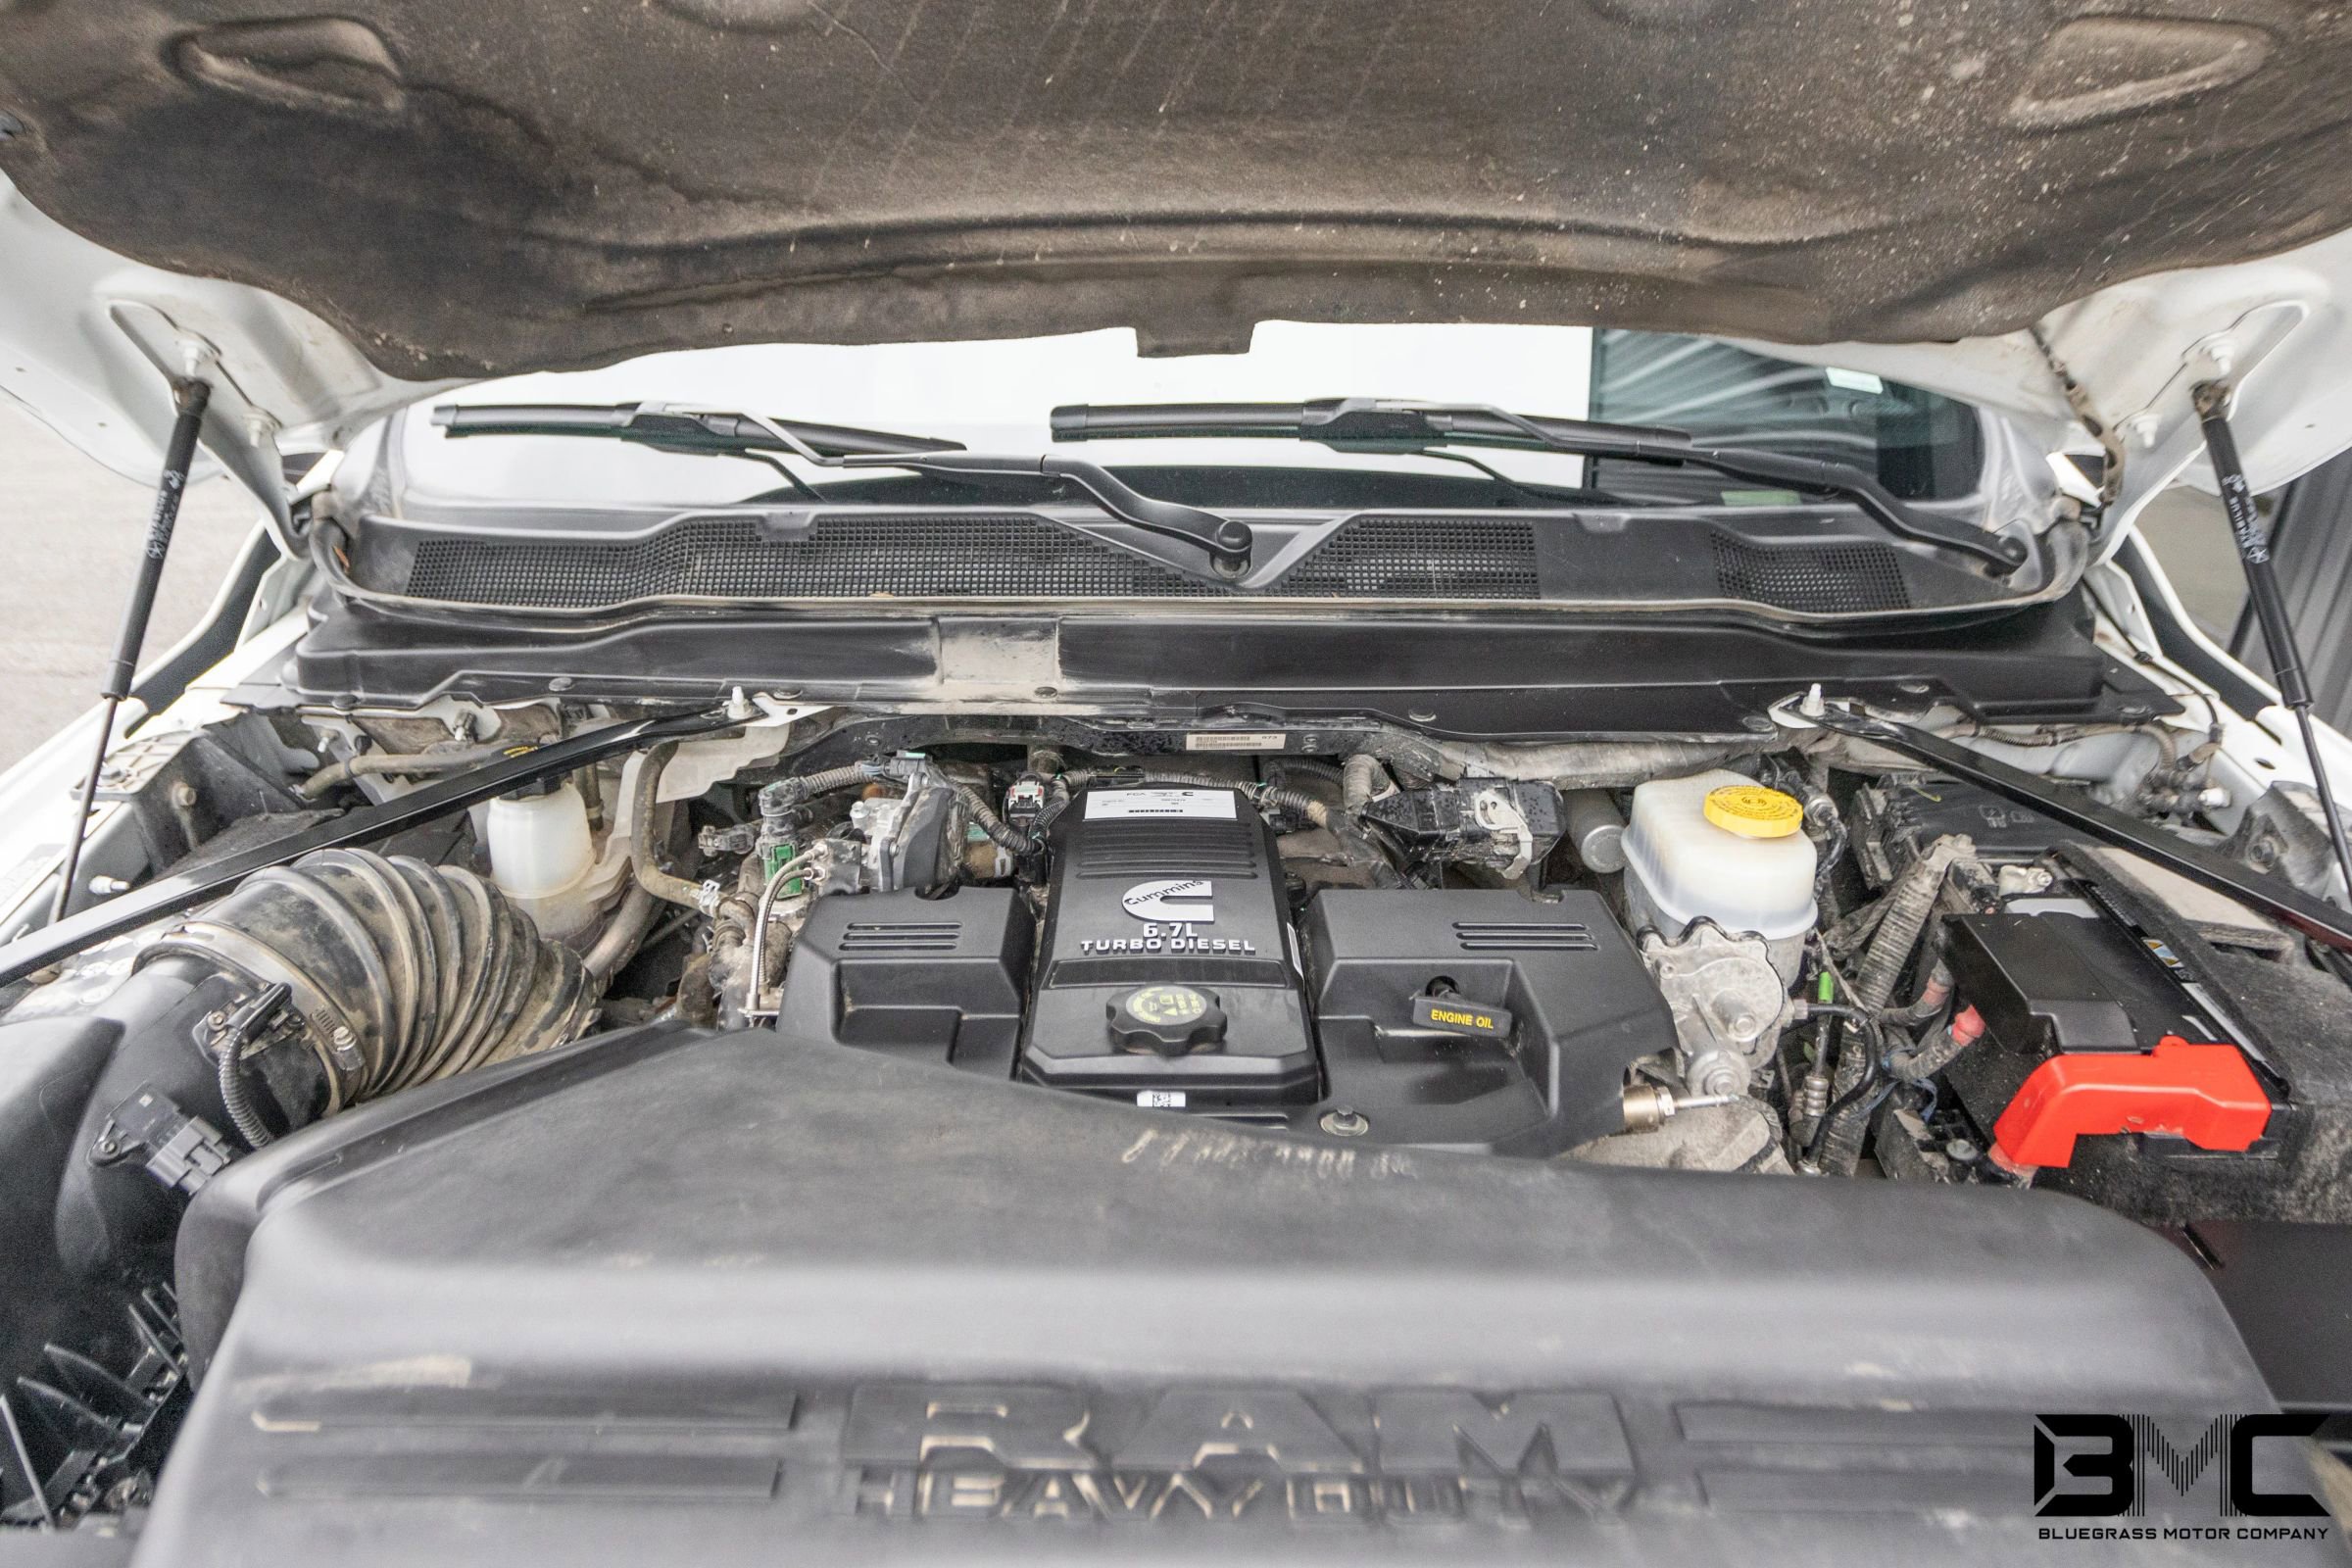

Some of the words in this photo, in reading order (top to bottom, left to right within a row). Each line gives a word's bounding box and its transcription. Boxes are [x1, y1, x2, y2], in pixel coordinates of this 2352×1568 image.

[1123, 880, 1204, 906] Cummins
[1143, 922, 1199, 939] 6.7L
[1080, 938, 1162, 954] TURBO
[1170, 938, 1256, 954] DIESEL
[1431, 1008, 1474, 1026] ENGINE
[1476, 1015, 1494, 1029] OIL
[844, 1384, 1641, 1471] RAM
[843, 1468, 1274, 1521] HEAVY
